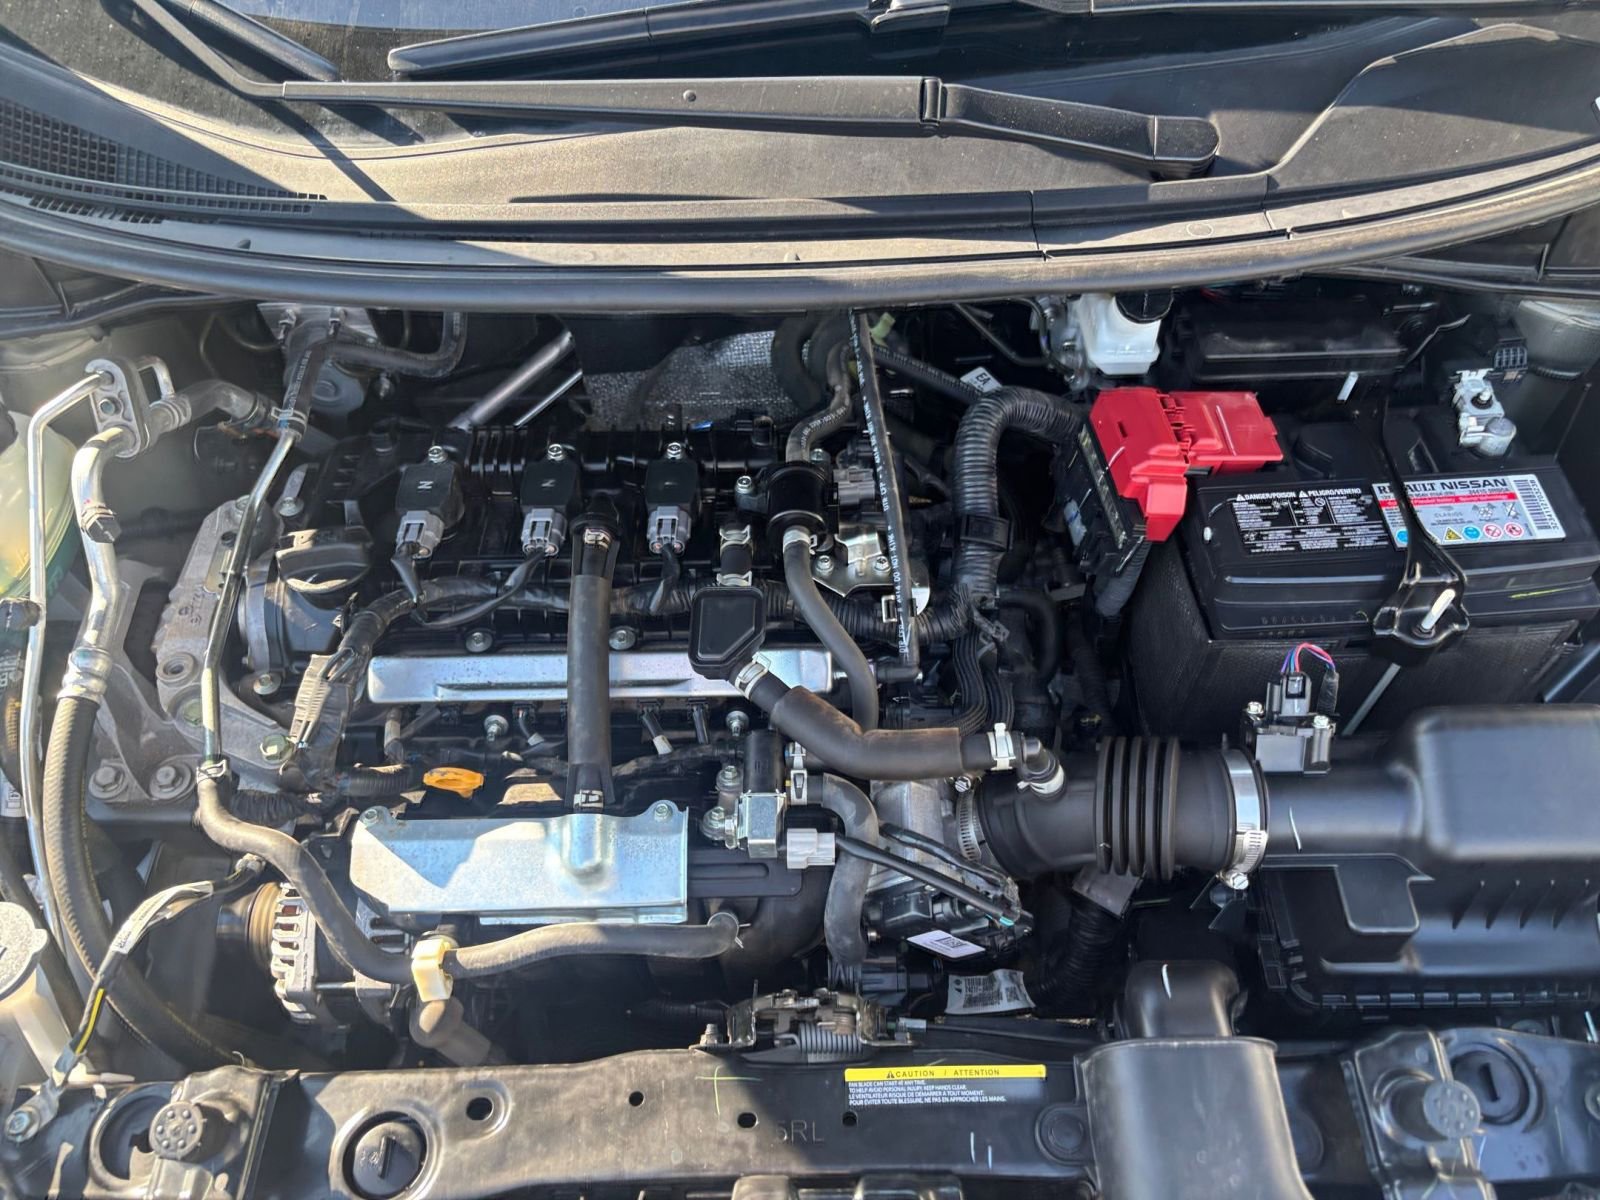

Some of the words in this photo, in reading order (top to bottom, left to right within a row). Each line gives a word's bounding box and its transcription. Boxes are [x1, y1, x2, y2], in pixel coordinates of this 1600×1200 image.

[1377, 482, 1436, 494] RAULT
[1440, 478, 1507, 490] NISSAN
[1244, 491, 1297, 500] DANGER/POISON
[1307, 488, 1361, 497] PELIGRO/VENENO
[887, 533, 897, 552] KINK
[890, 554, 900, 569] NOT
[896, 1070, 935, 1078] CAUTION
[953, 1068, 1000, 1076] ATTENTION
